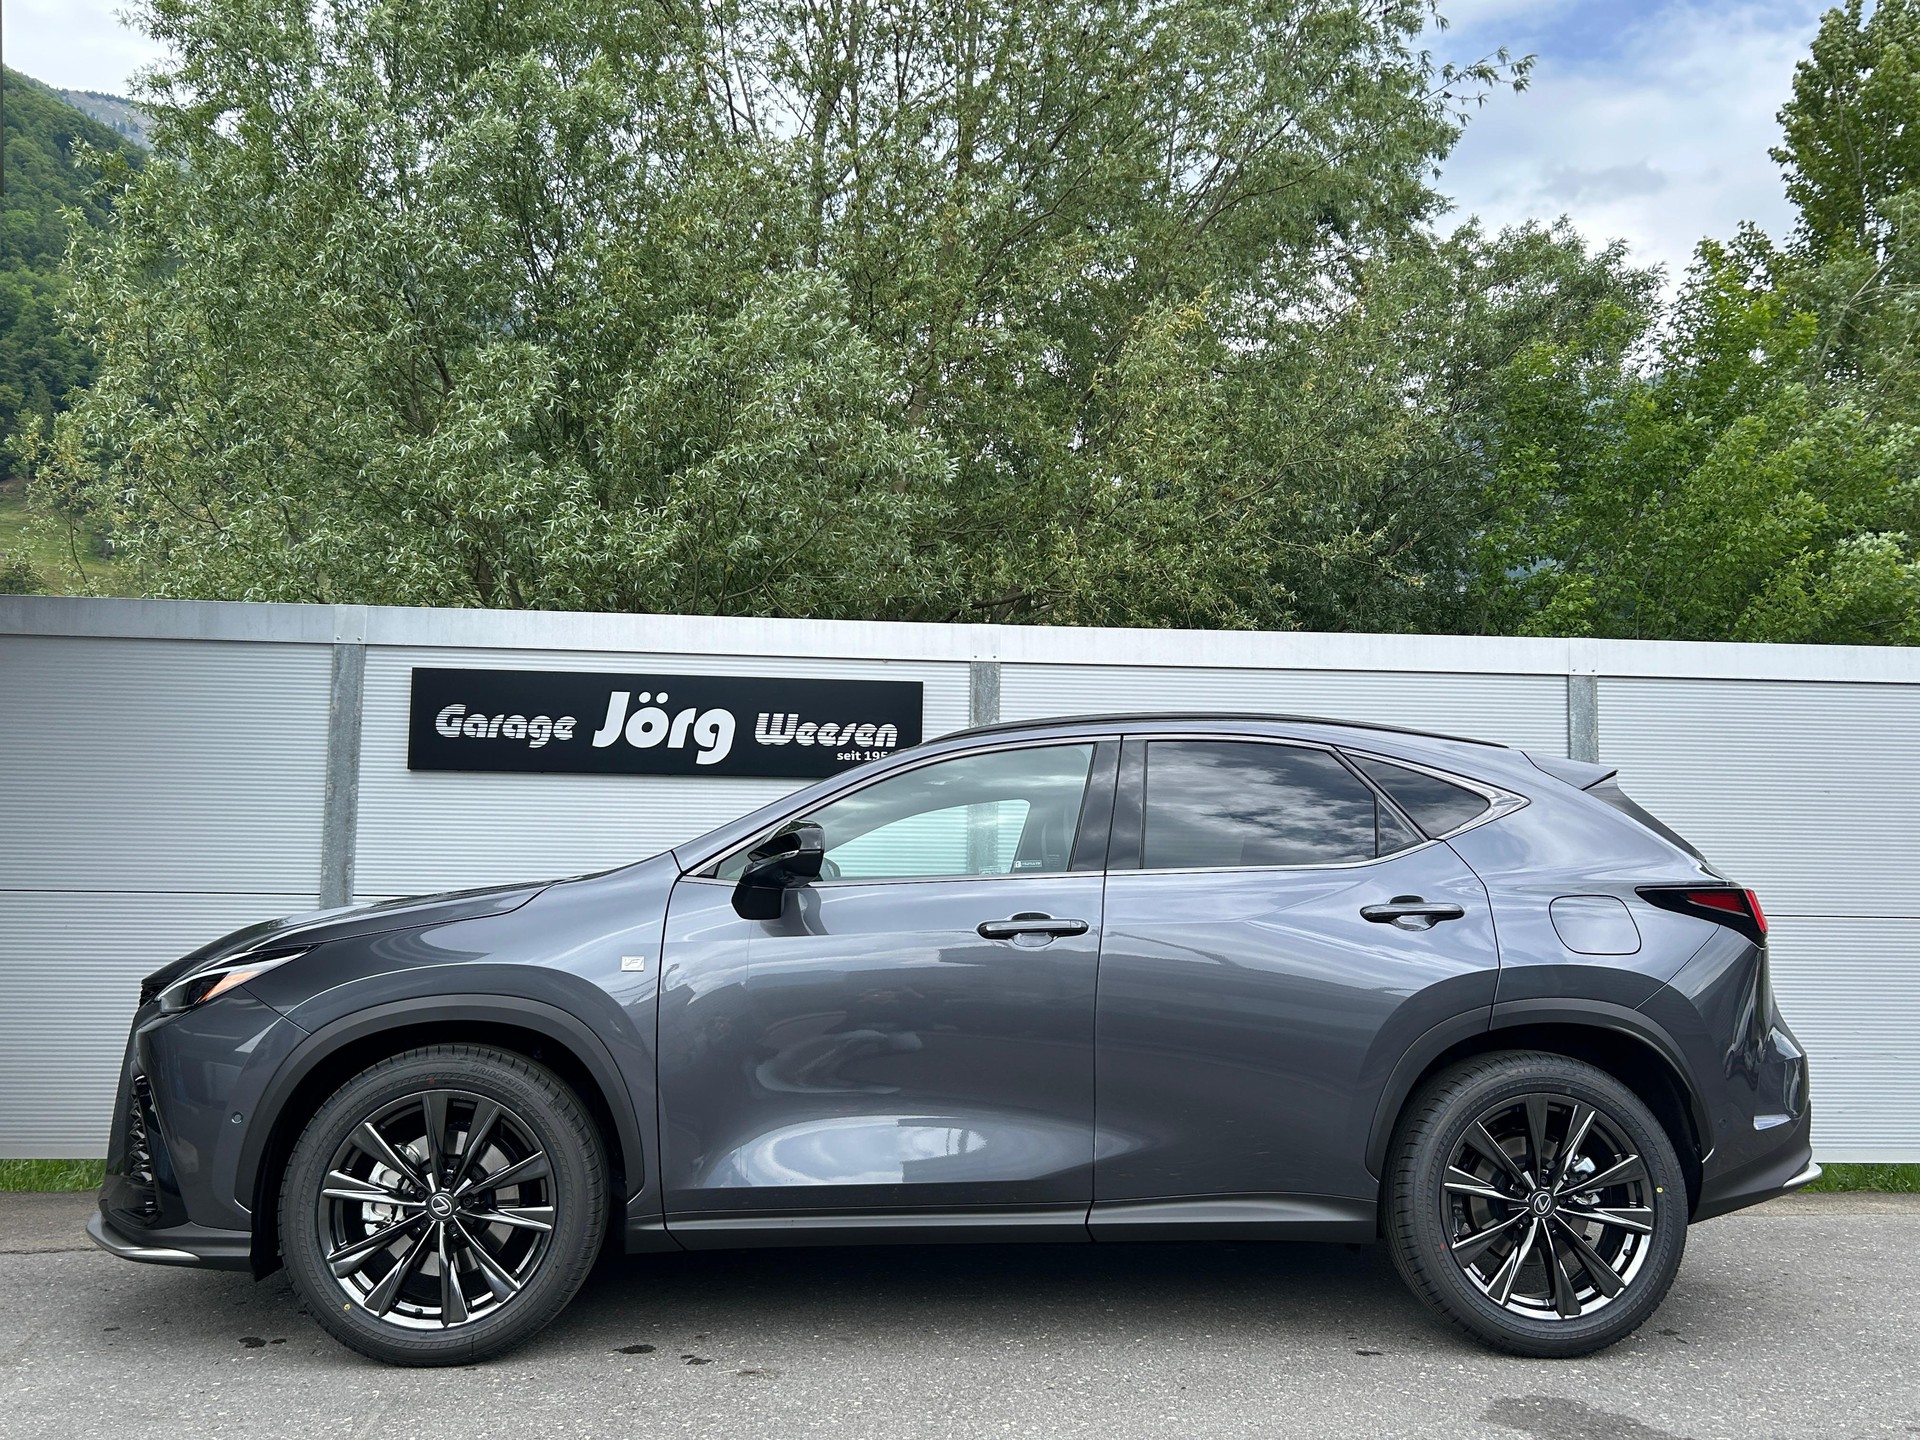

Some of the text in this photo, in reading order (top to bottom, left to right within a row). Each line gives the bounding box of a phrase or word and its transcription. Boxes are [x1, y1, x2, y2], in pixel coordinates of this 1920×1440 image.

[435, 691, 898, 765] Garage Jörg Weesen
[836, 750, 888, 761] seit 195
